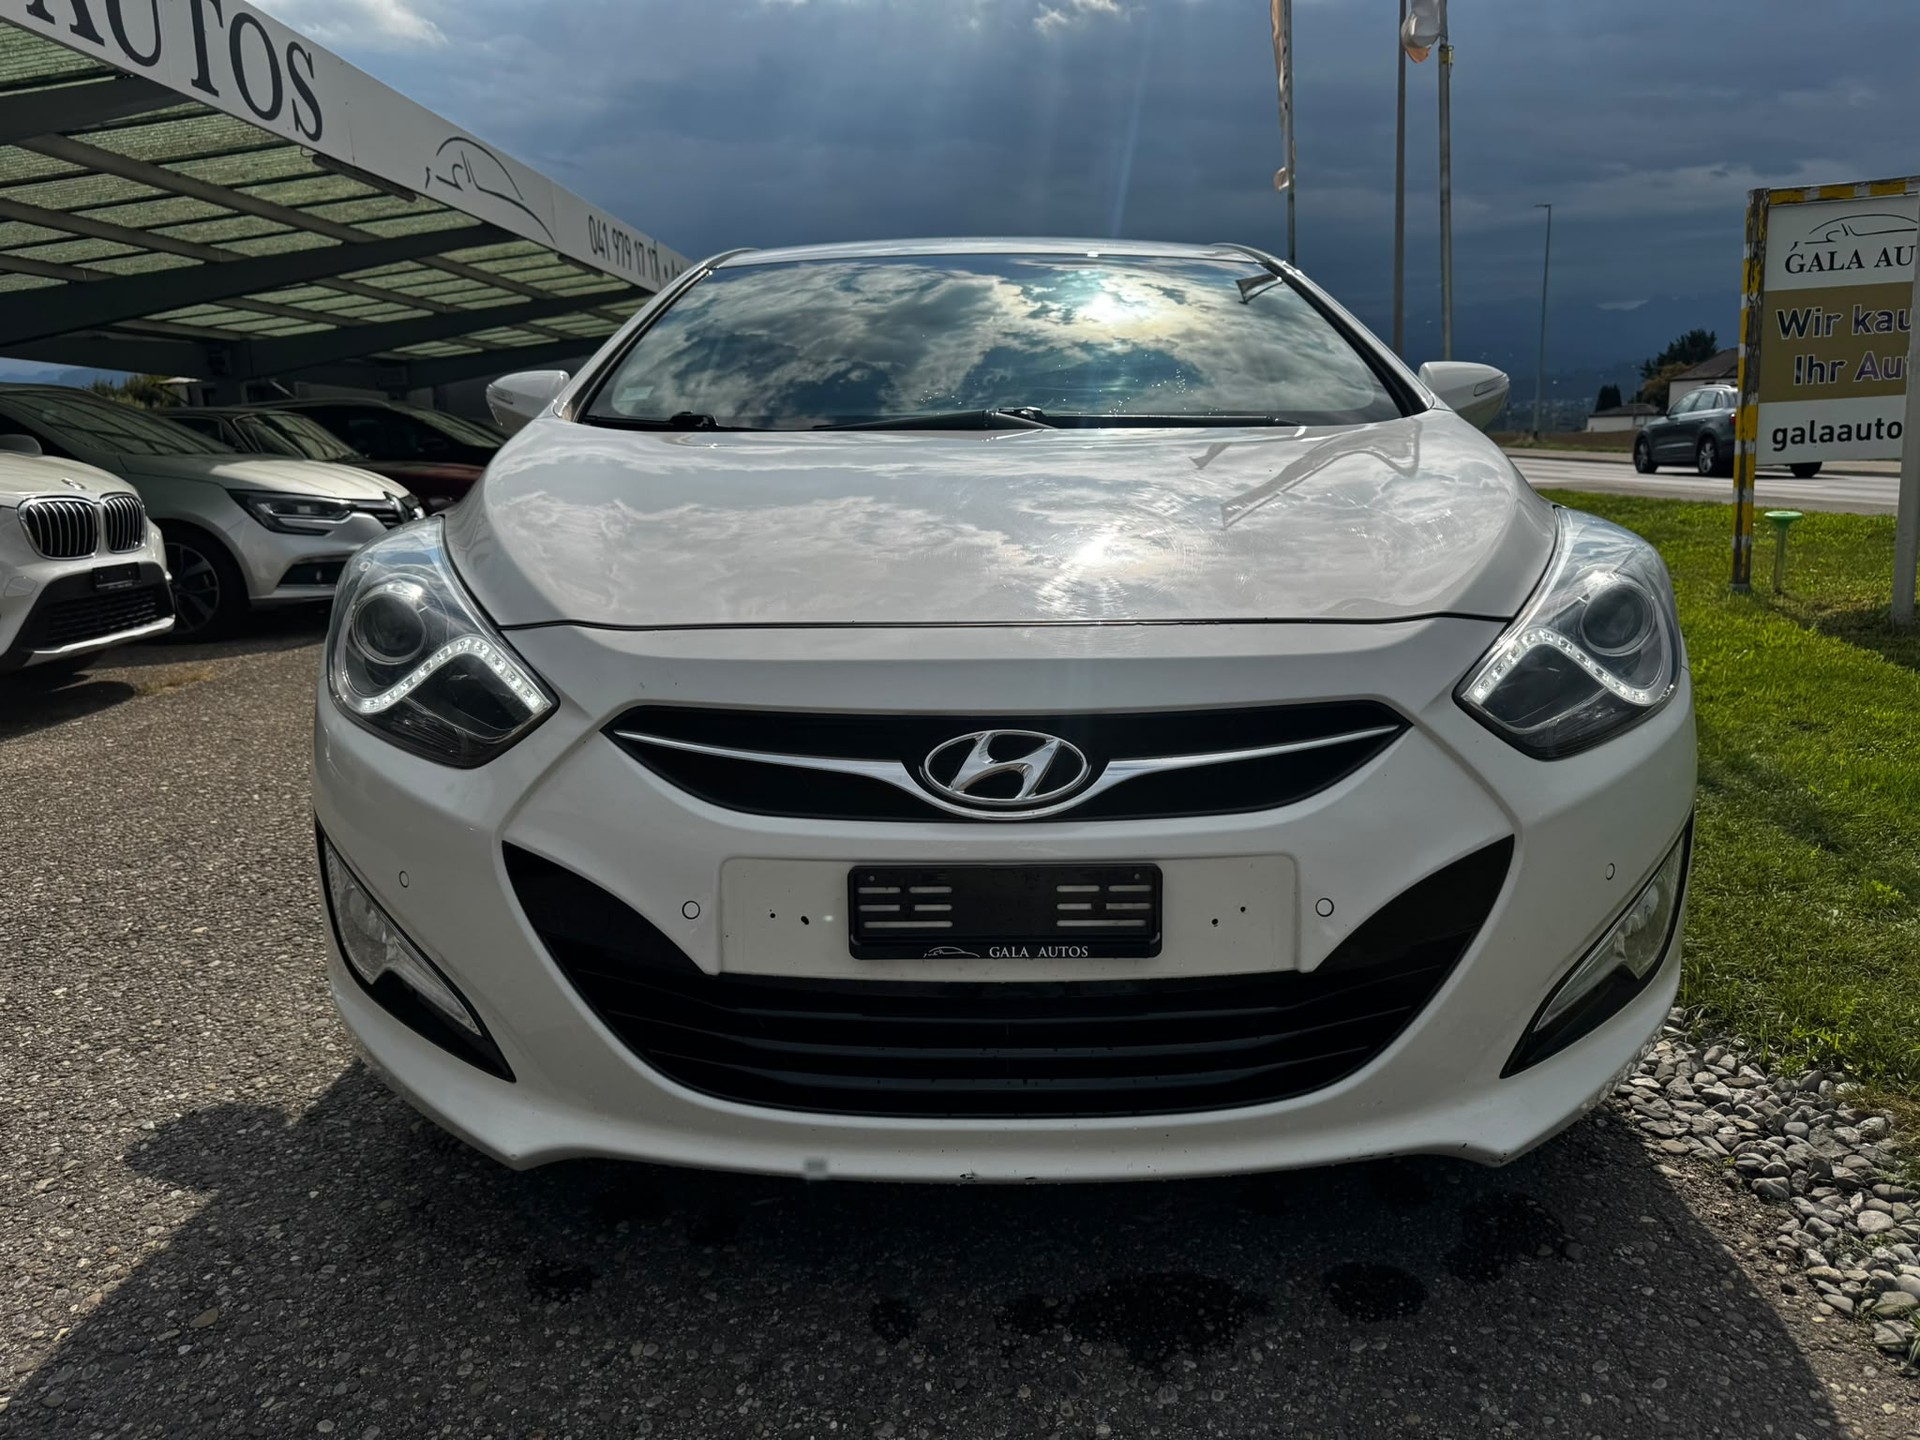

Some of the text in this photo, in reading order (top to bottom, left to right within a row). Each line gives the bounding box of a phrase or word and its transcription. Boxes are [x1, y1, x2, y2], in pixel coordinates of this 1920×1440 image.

[588, 214, 610, 262] 041
[612, 227, 632, 271] 979
[634, 240, 645, 278] 17
[1785, 248, 1865, 274] GALA
[1776, 306, 1842, 340] Wir
[1793, 353, 1847, 385] Ihr
[989, 945, 1088, 958] GALA AUTOS
